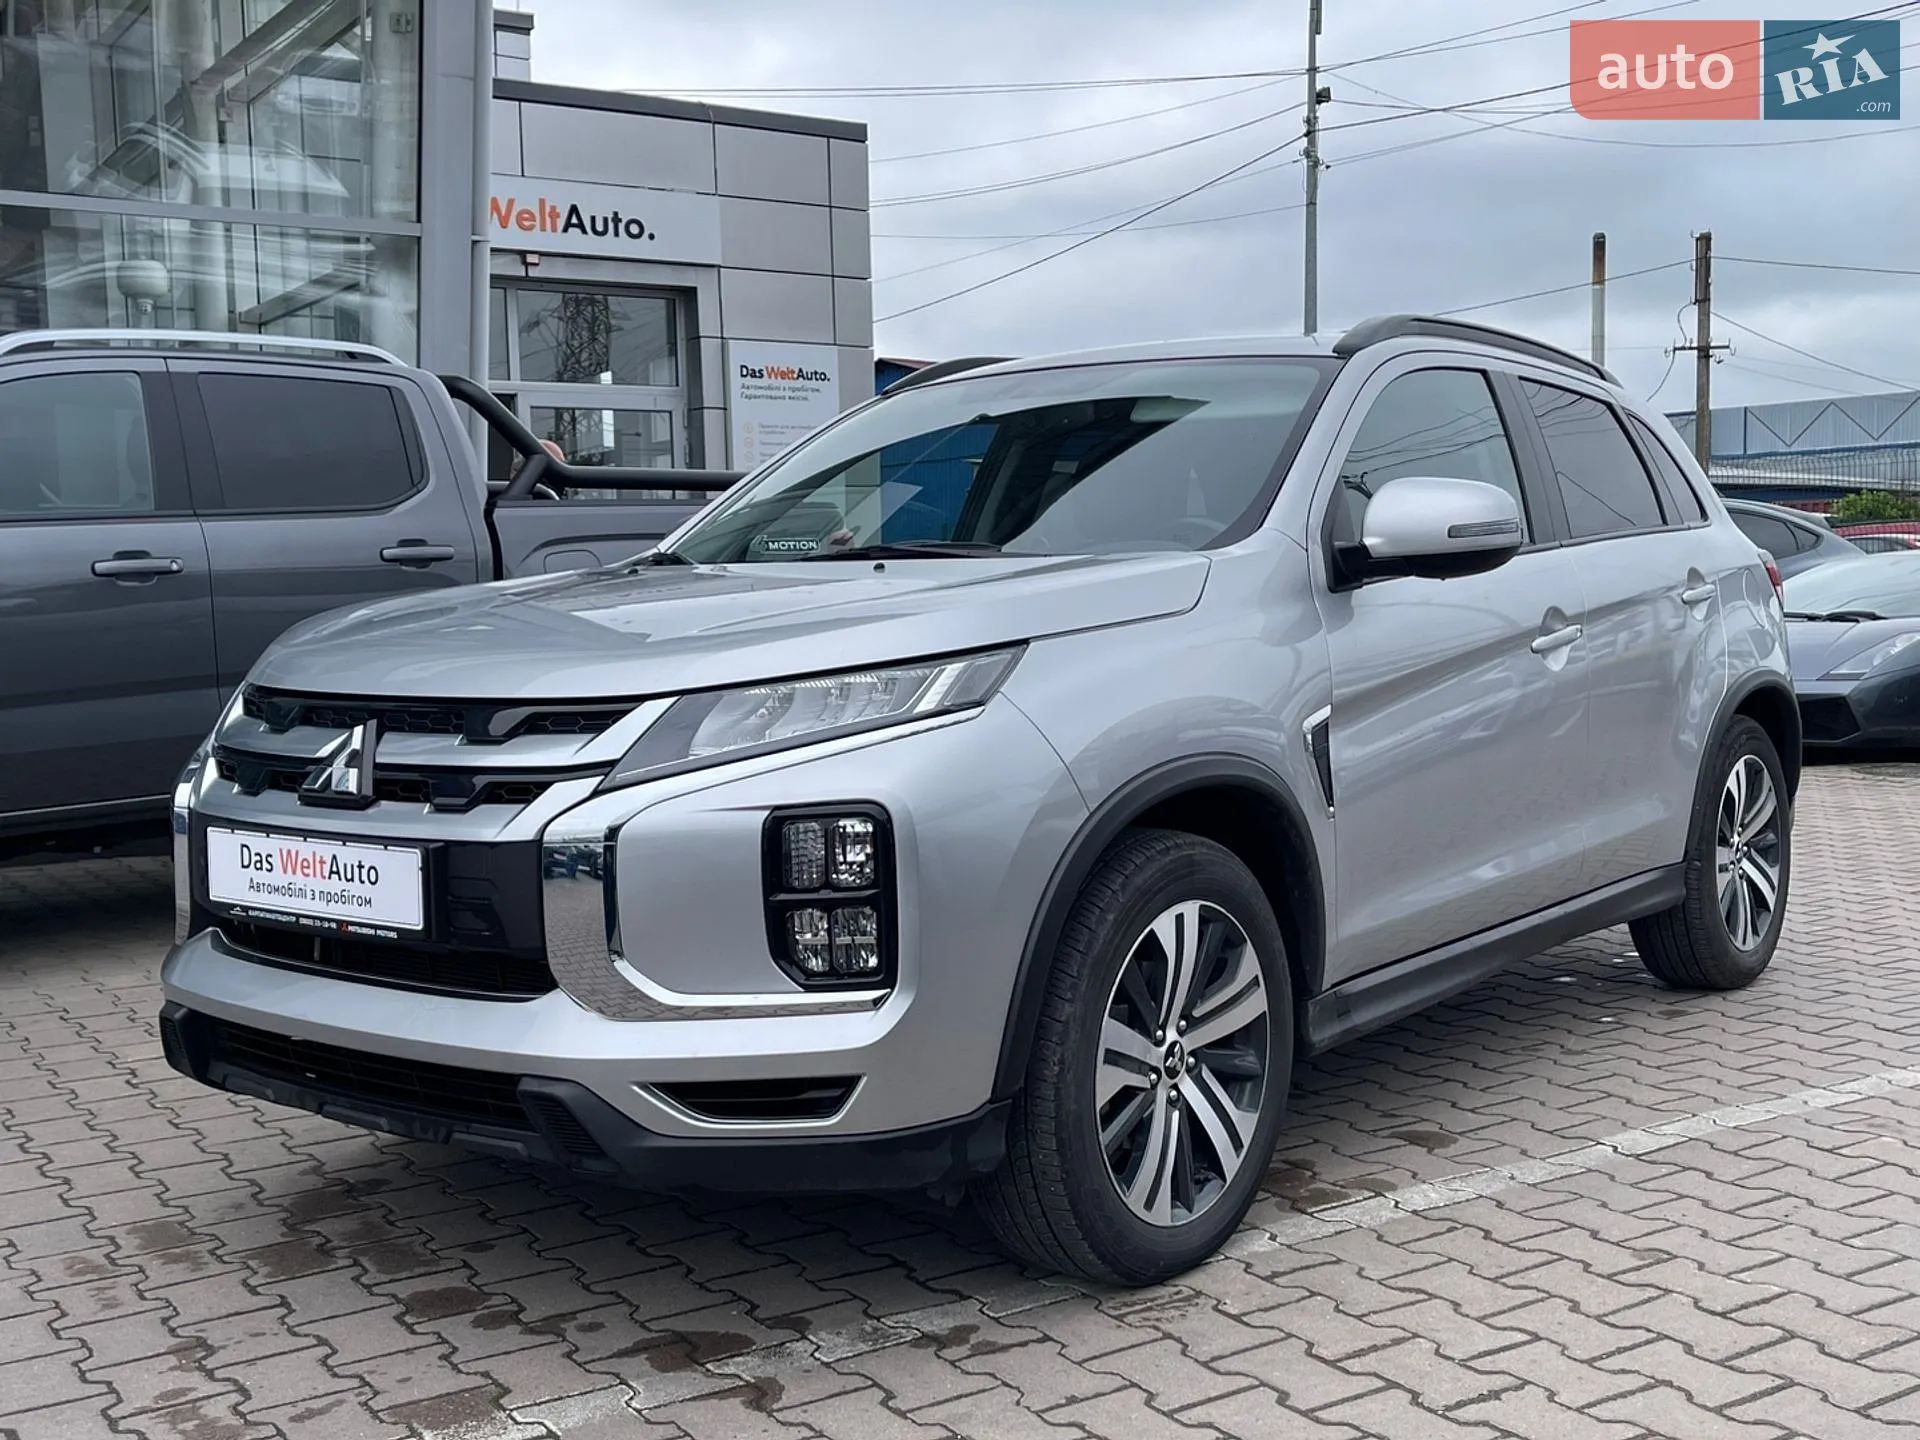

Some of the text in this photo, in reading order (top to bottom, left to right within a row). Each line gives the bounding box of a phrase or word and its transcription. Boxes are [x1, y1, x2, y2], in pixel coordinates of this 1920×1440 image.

[740, 364, 831, 382] Das WeltAuto.
[240, 843, 379, 886] Das WeltAuto
[248, 877, 372, 908] Автомобілі з пробігом
